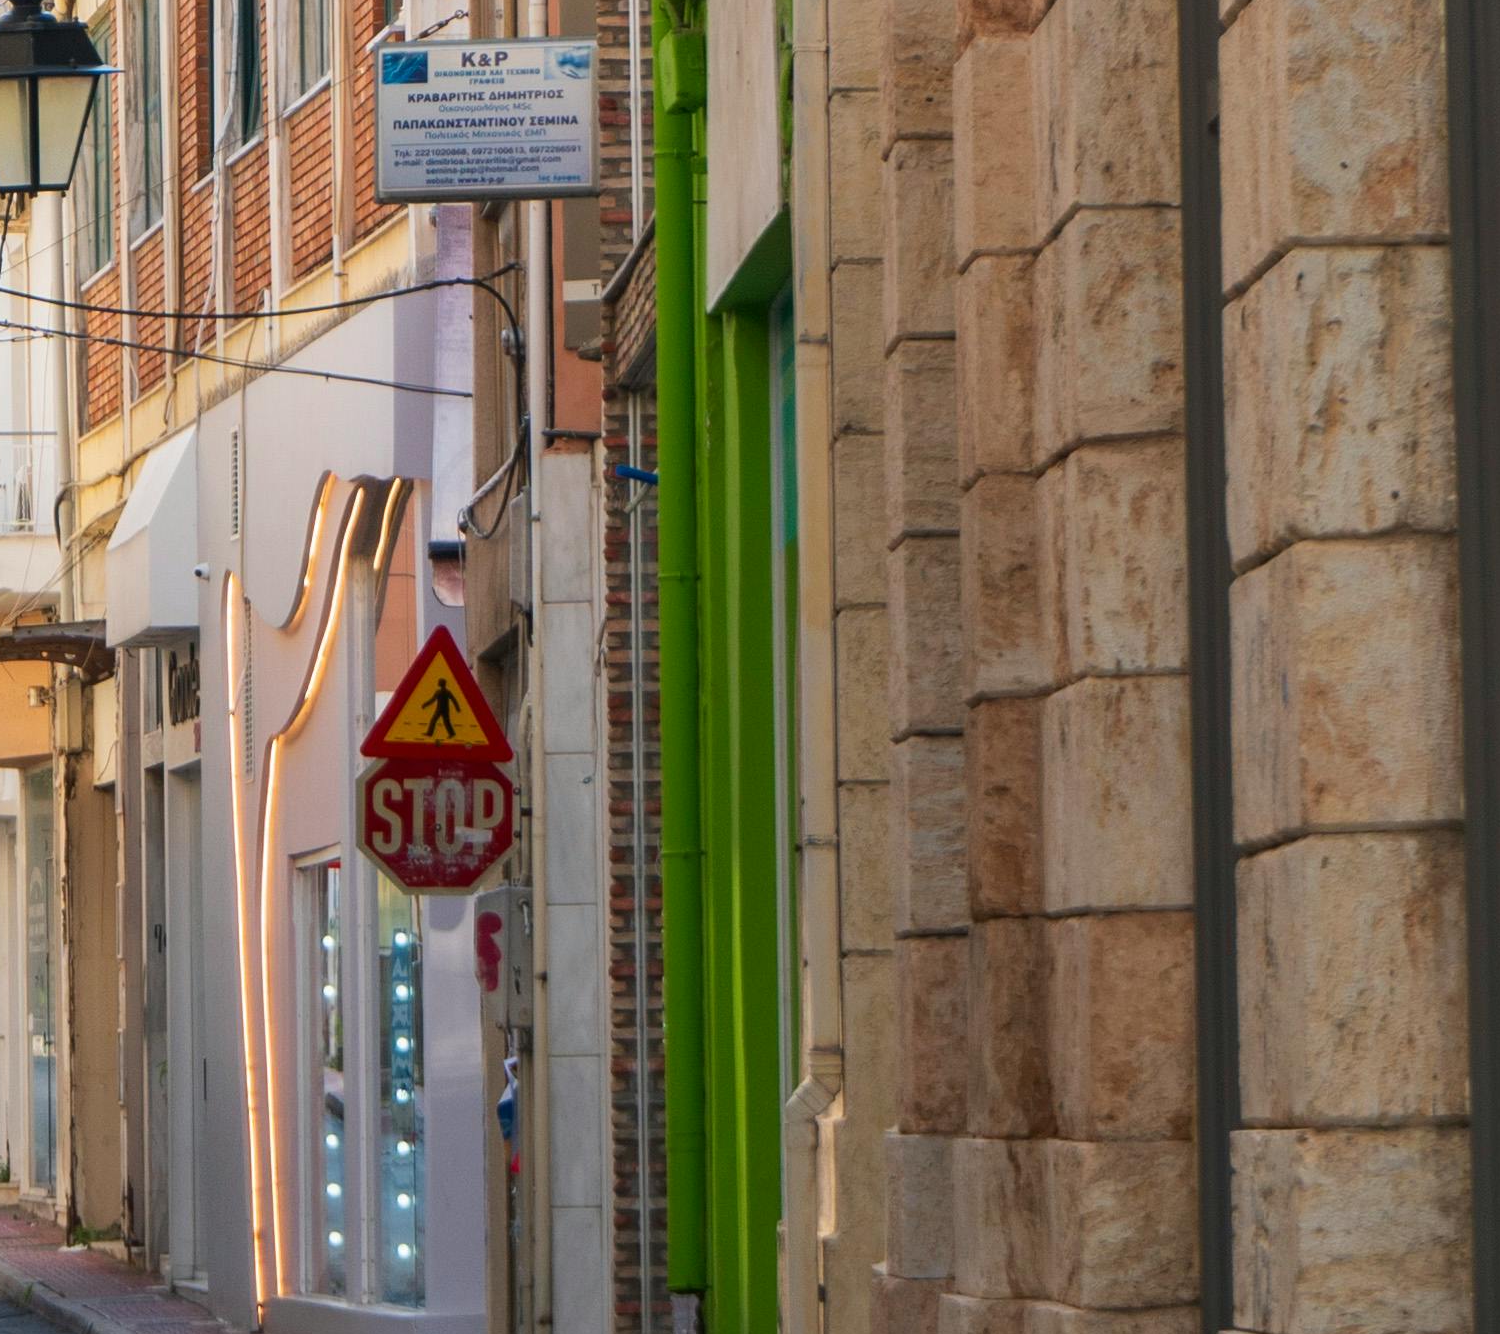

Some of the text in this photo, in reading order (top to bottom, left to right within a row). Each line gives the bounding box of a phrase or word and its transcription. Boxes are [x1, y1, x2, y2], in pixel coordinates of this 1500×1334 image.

[461, 51, 508, 68] K&P
[407, 89, 565, 104] ΚΡΑΒΑΡΙΤΗΣ ΔΗΜΗΤΡΙΟΣ
[393, 116, 579, 130] ΠΑΠΑΚΩΝΣΤΑΝΤΙΝΟΥ ΣΕΜΙΝΑ
[371, 777, 505, 855] STOP
